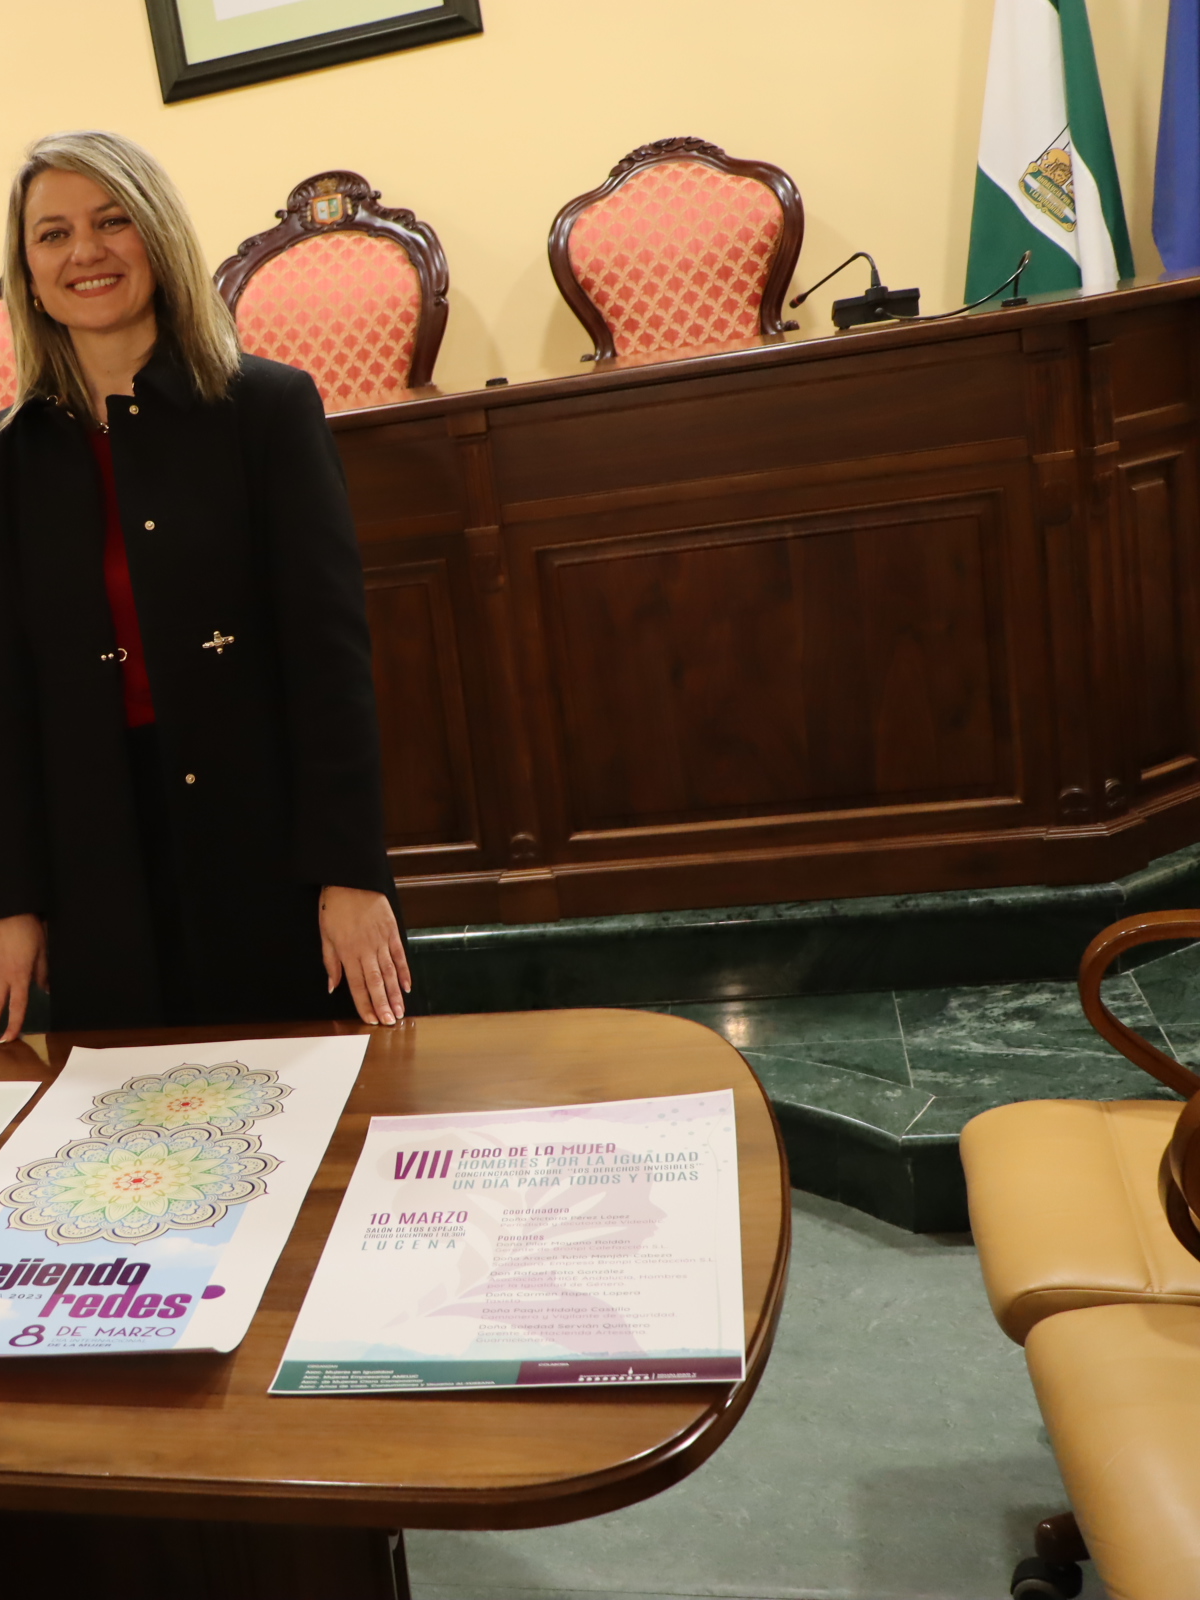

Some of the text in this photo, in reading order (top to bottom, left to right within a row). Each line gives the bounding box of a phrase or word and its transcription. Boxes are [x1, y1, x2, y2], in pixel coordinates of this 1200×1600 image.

[461, 1142, 616, 1159] FORO DE LA MUJER
[394, 1149, 453, 1180] VIII
[457, 1151, 699, 1170] HOMBRES POR LA IGUALDAD
[452, 1170, 699, 1190] UN DÍA PARA TODOS Y TODAS
[454, 1168, 532, 1178] CONCIENCIACIÓN
[534, 1168, 563, 1176] SOBRE
[593, 1165, 641, 1174] DERECHOS
[370, 1210, 469, 1225] 10 MARZO
[502, 1206, 570, 1215] Coordinadora
[365, 1226, 393, 1234] SALÓN
[361, 1239, 456, 1251] LUCENA
[37, 1288, 192, 1320] redes
[8, 1323, 177, 1349] 8 DE MARZO
